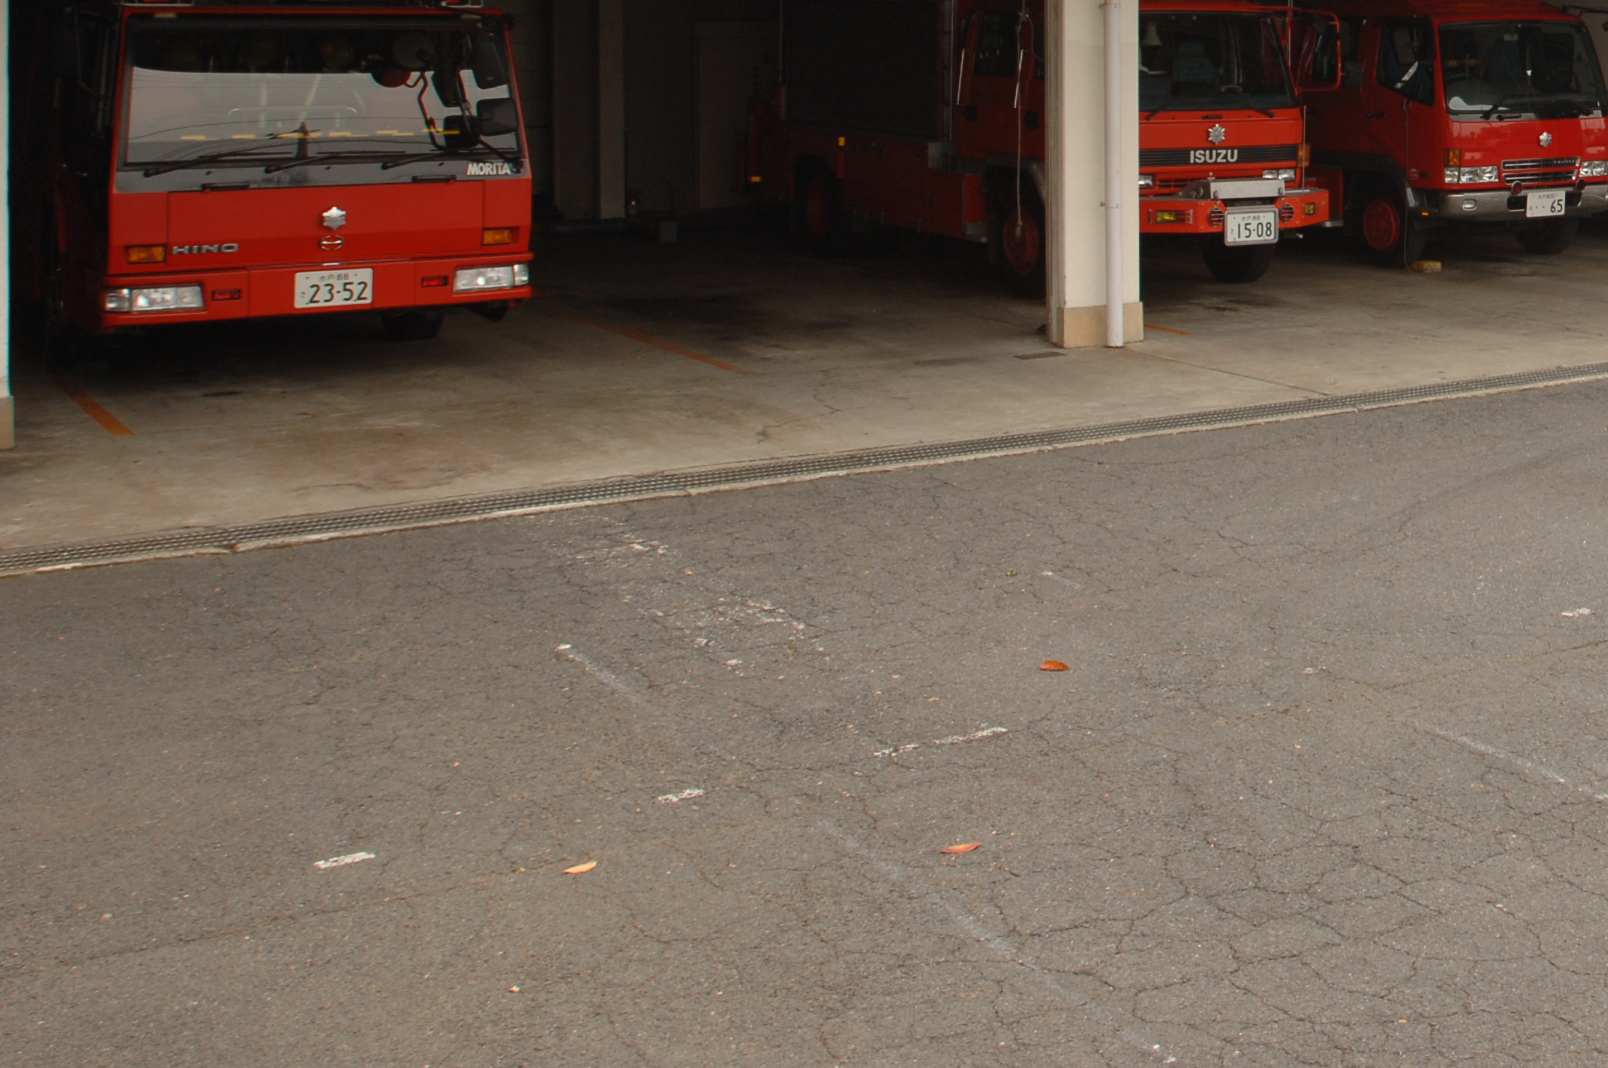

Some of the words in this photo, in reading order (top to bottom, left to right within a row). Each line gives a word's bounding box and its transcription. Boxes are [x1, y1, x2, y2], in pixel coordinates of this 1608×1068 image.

[1189, 149, 1239, 164] ISUZU
[466, 162, 512, 176] MORITA
[172, 242, 239, 255] HINO
[307, 281, 368, 304] 23-52
